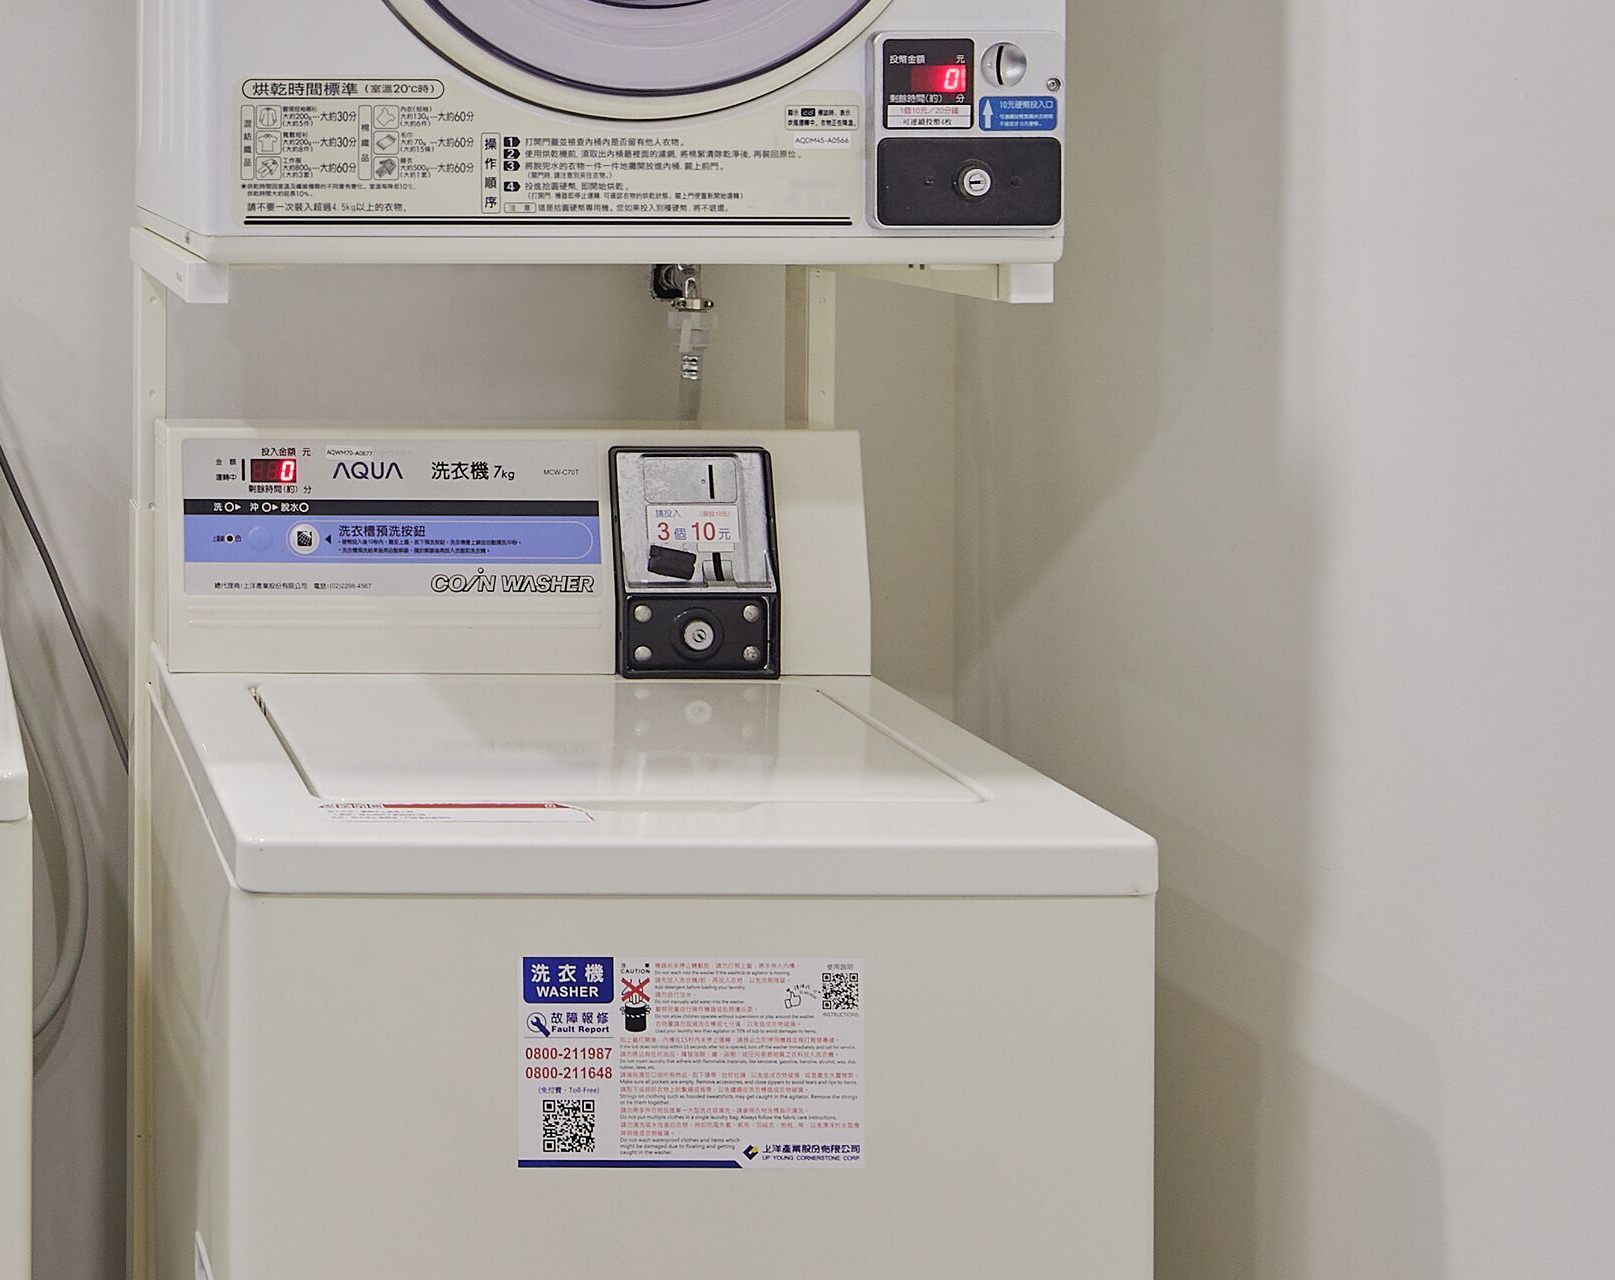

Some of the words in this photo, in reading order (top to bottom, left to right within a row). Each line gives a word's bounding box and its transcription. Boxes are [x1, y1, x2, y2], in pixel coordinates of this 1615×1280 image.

[956, 55, 966, 64] 元
[944, 68, 960, 90] 0
[252, 82, 358, 96] 烘乾時間標準
[956, 94, 965, 103] 分
[320, 111, 357, 122] 大約30分
[437, 111, 474, 122] 大約60分
[320, 137, 357, 148] 大約30分
[437, 137, 474, 148] 大約60分
[320, 162, 357, 173] 大約60分
[437, 162, 474, 173] 大約60分
[484, 138, 497, 208] 操作順序
[280, 460, 295, 481] 0
[332, 462, 404, 479] AQUA
[431, 461, 489, 480] 洗衣機
[494, 465, 515, 480] 7kg
[658, 522, 670, 540] 3
[674, 528, 686, 540] 個
[692, 522, 716, 541] 10
[718, 528, 731, 540] 元
[431, 567, 496, 593] COIN
[501, 574, 594, 593] WASHER
[531, 964, 604, 983] 洗衣機
[536, 986, 599, 998] WASHER
[551, 1012, 609, 1024] 故障報修
[578, 1026, 610, 1034] Report
[526, 1048, 613, 1060] 0800-211987
[526, 1067, 613, 1079] 0800-211648
